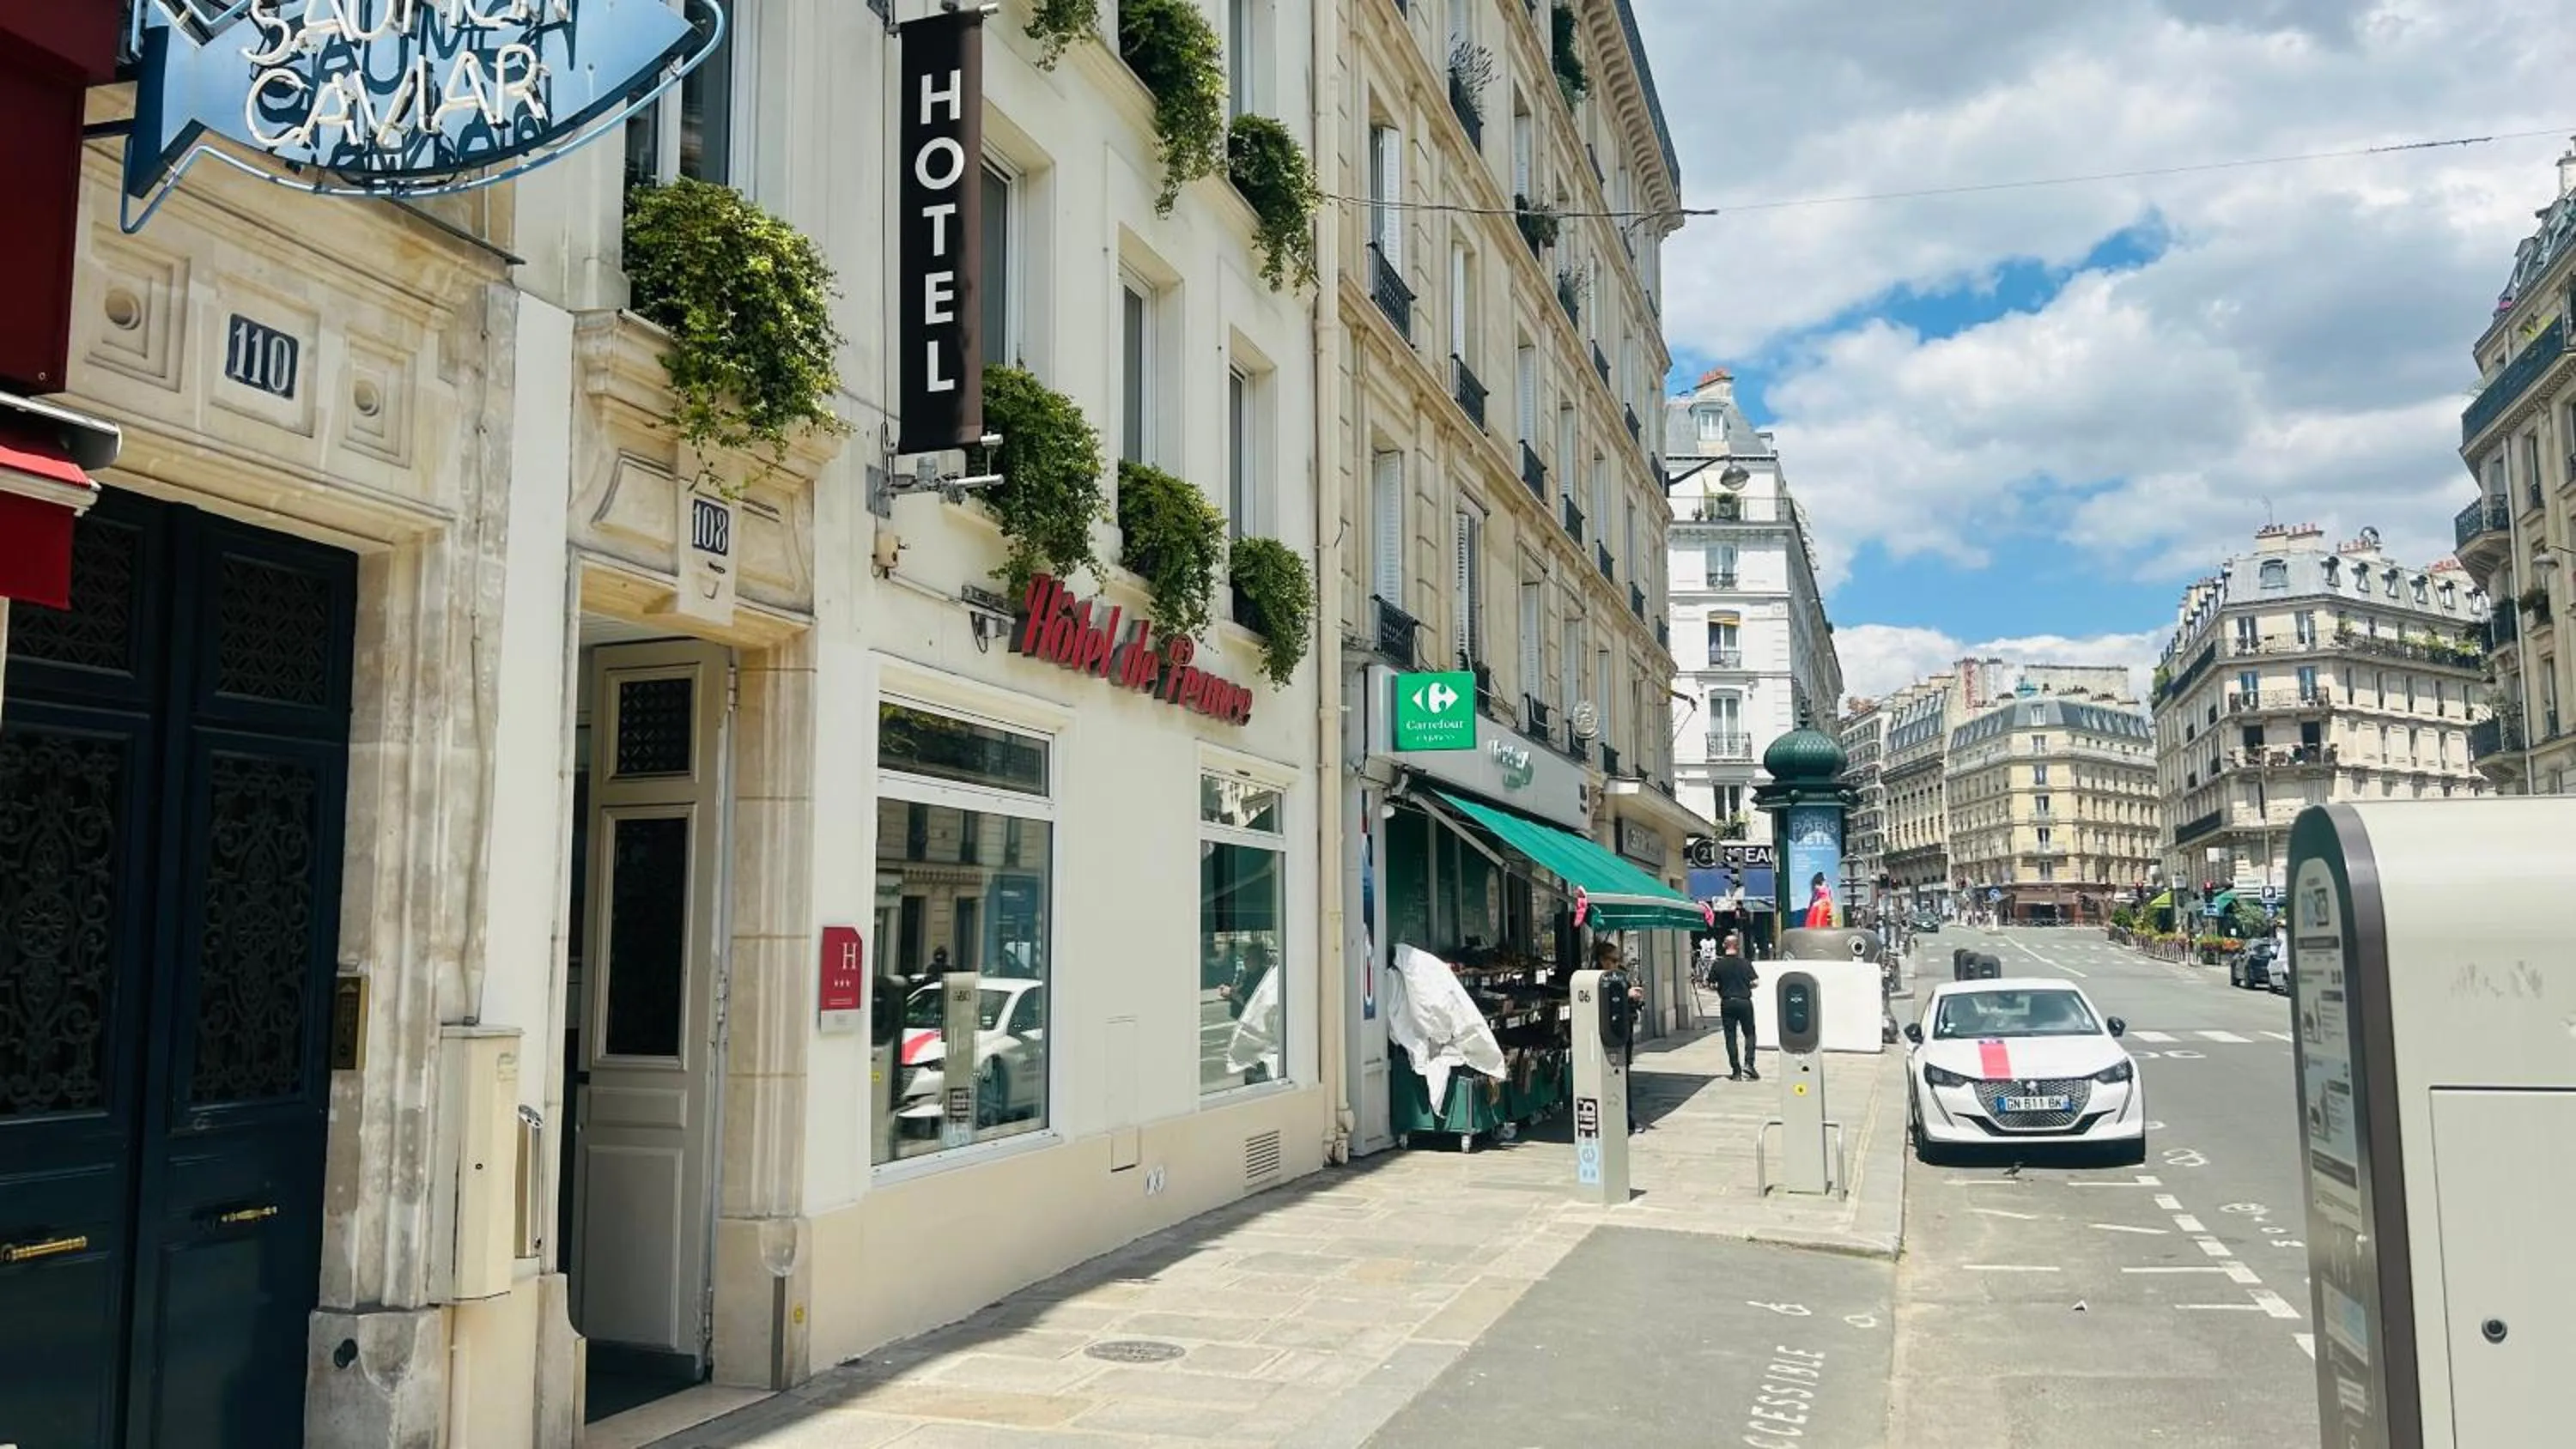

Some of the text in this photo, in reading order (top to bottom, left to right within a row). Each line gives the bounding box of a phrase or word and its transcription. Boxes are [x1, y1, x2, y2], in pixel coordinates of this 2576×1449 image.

[246, 44, 555, 147] CAVIAR
[914, 69, 964, 392] HOTEL
[233, 323, 290, 391] 110
[694, 504, 726, 552] 108
[1022, 573, 1121, 678] Hôtel
[1120, 620, 1159, 694] de
[1406, 718, 1463, 731] Carrefour
[842, 943, 857, 970] H
